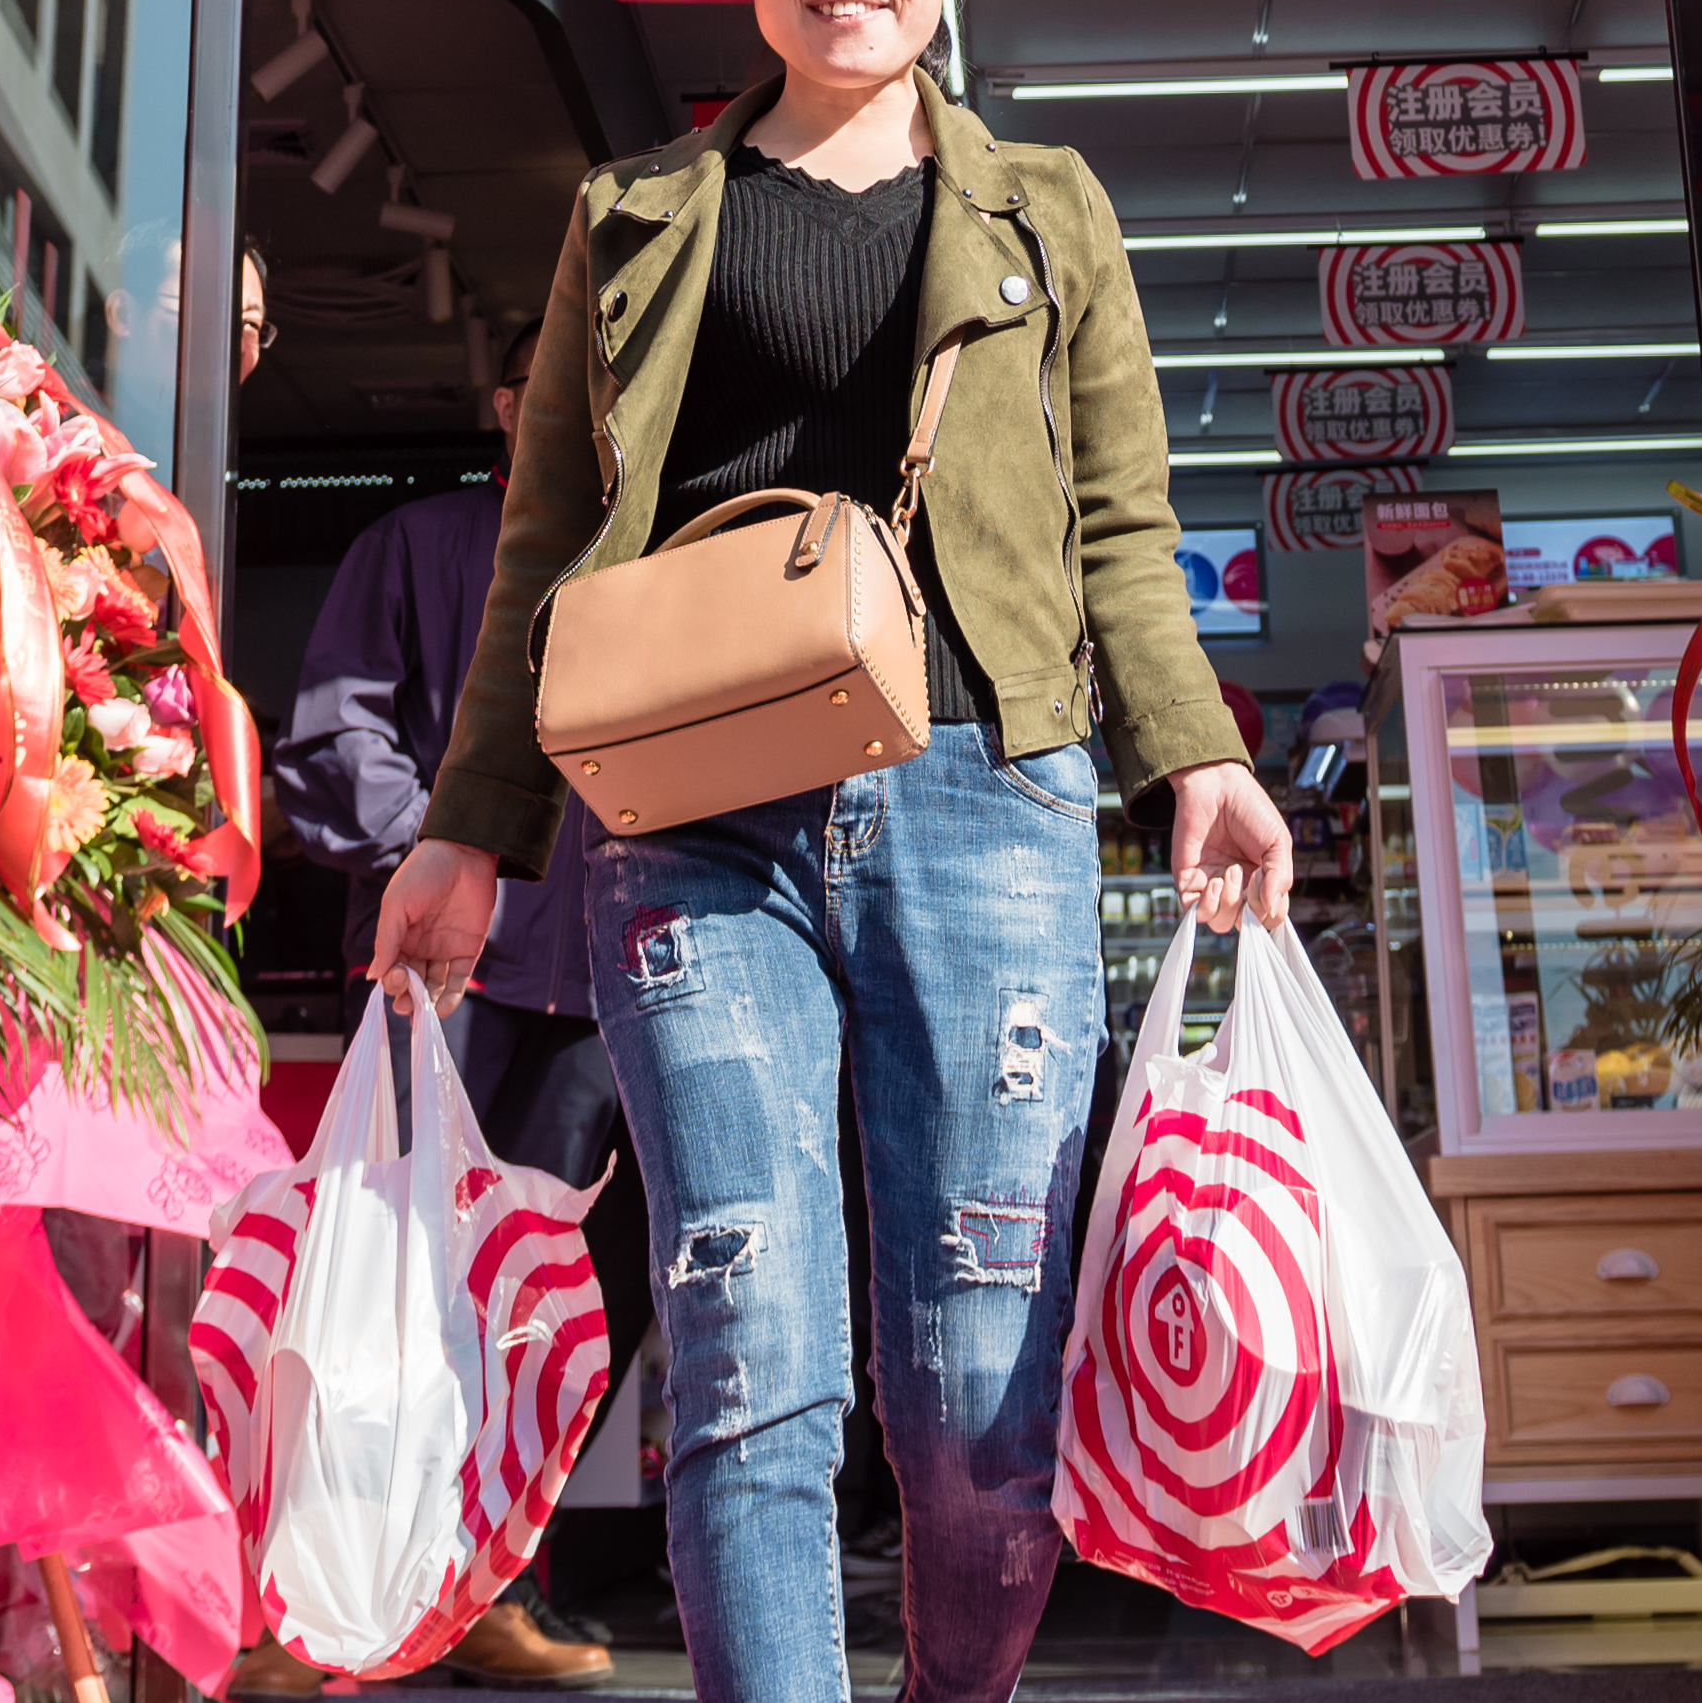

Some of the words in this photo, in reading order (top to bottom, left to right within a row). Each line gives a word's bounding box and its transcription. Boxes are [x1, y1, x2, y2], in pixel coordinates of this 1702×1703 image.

[1386, 79, 1545, 124] 注册会员
[1390, 122, 1548, 157] 领取优惠券!
[1352, 260, 1490, 297] 注册会员
[1355, 296, 1492, 327] 领取优惠券!
[1302, 382, 1424, 416] 注册会员
[1304, 415, 1425, 444] 领取优惠券!
[1294, 512, 1363, 536] 领取优
[1376, 501, 1450, 521] 新鲜面包
